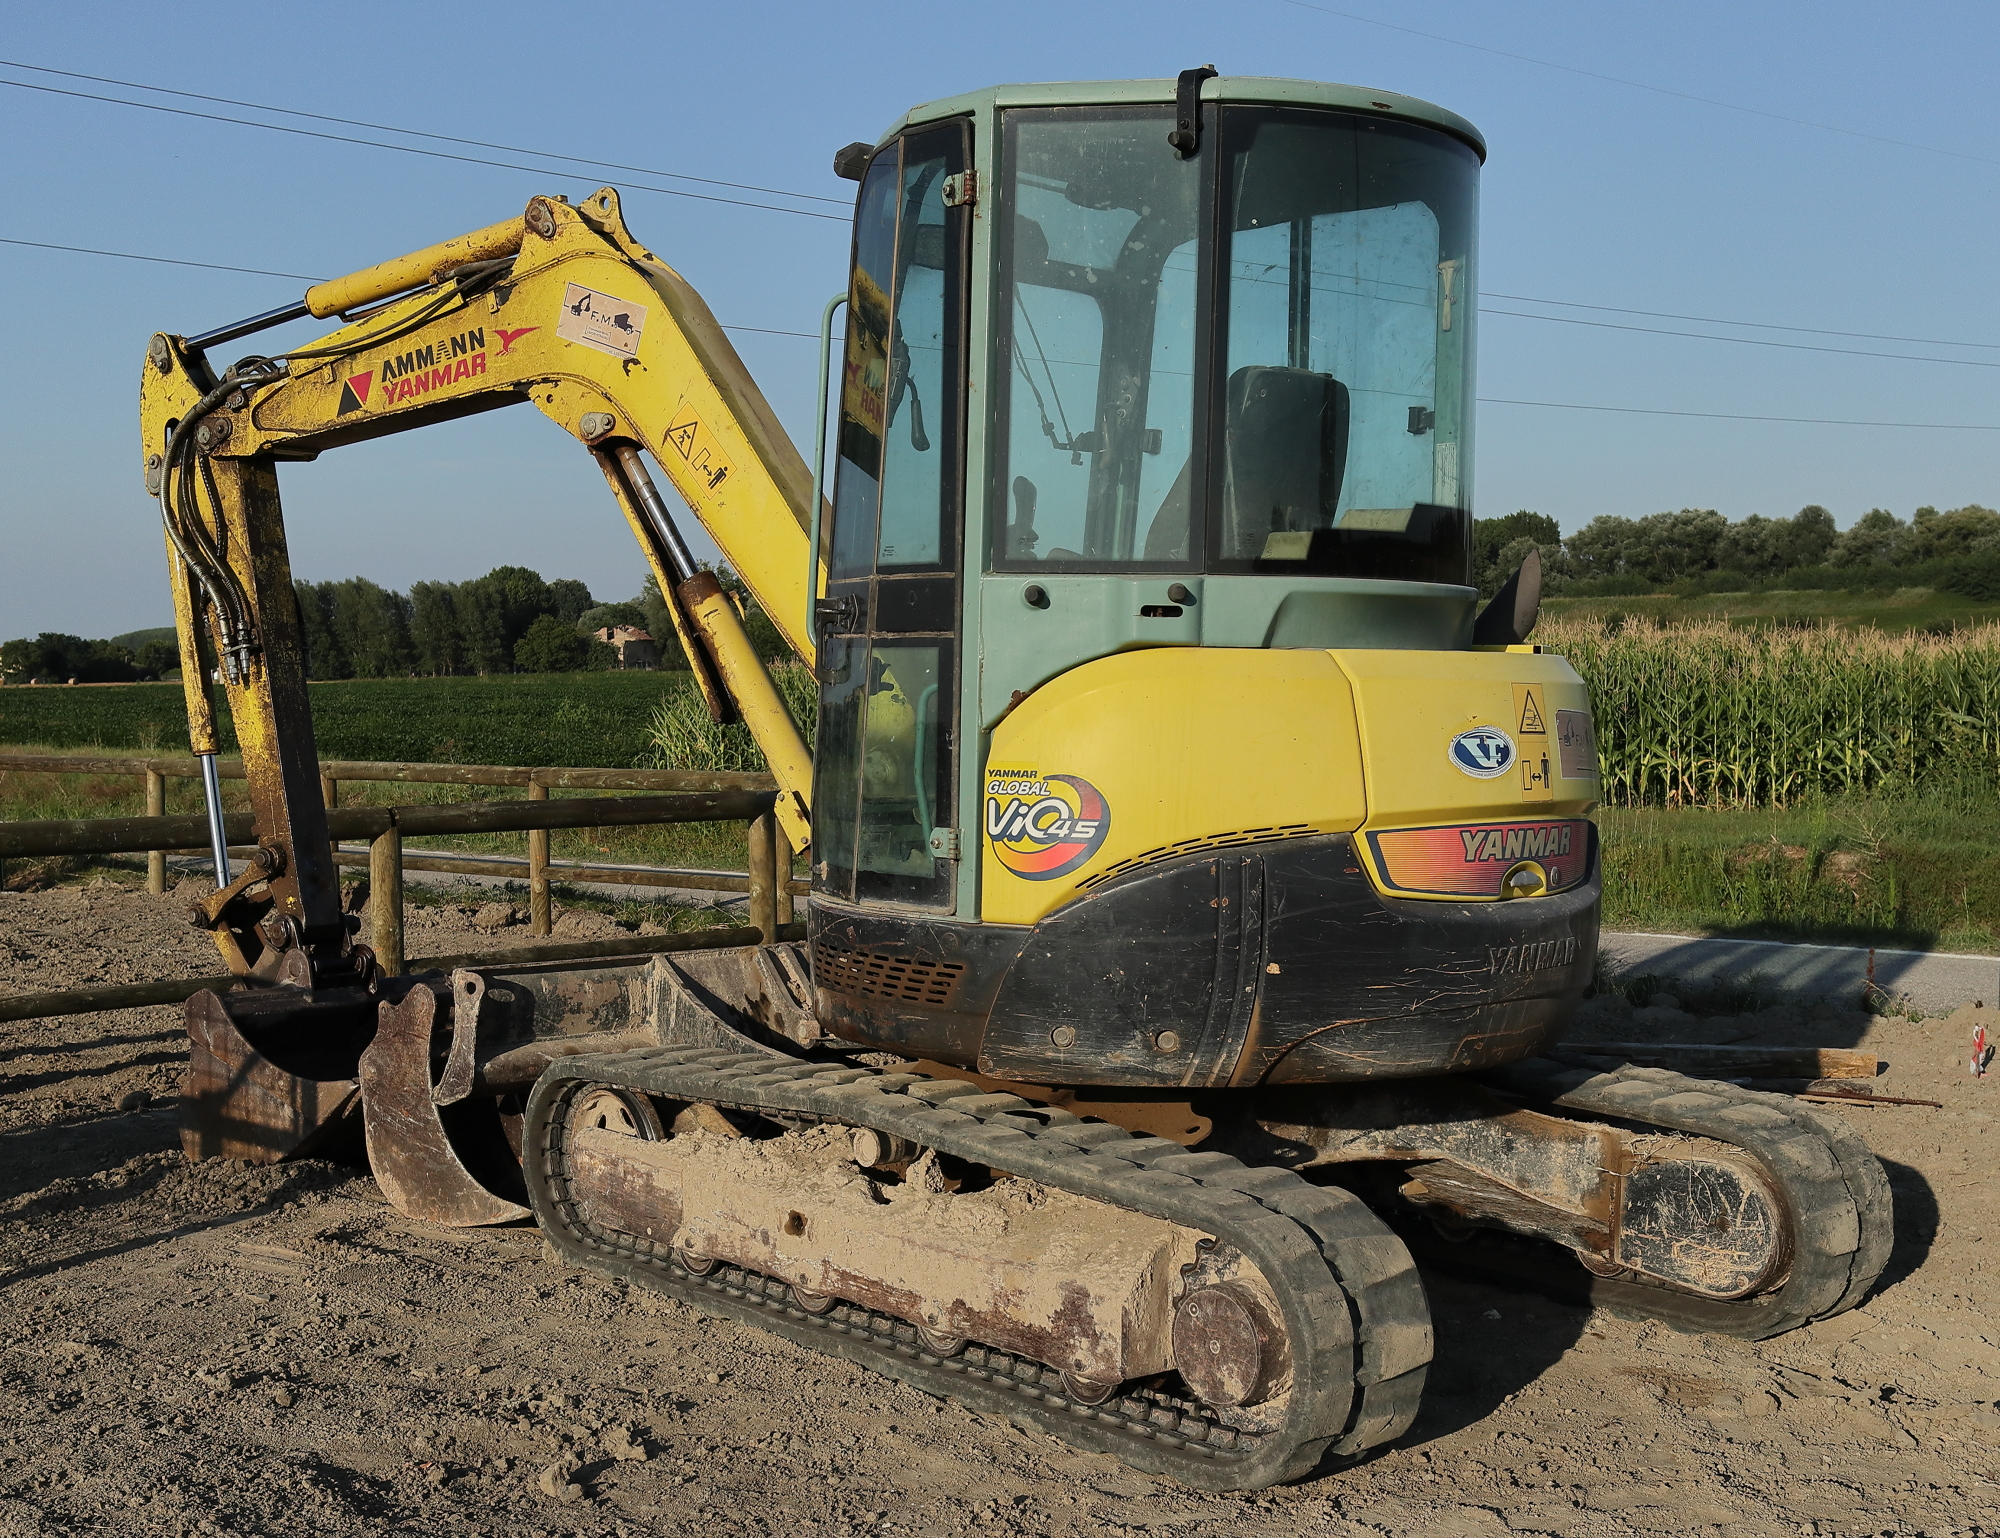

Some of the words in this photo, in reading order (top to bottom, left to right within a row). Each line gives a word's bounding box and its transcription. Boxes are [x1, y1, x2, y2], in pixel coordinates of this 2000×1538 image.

[381, 327, 486, 383] AMMANN
[382, 352, 487, 405] YANMAR
[987, 769, 1038, 779] YANMAR
[987, 780, 1051, 796] GLOBAL
[1460, 825, 1571, 862] YANMAR
[1489, 937, 1576, 975] YANMAR
